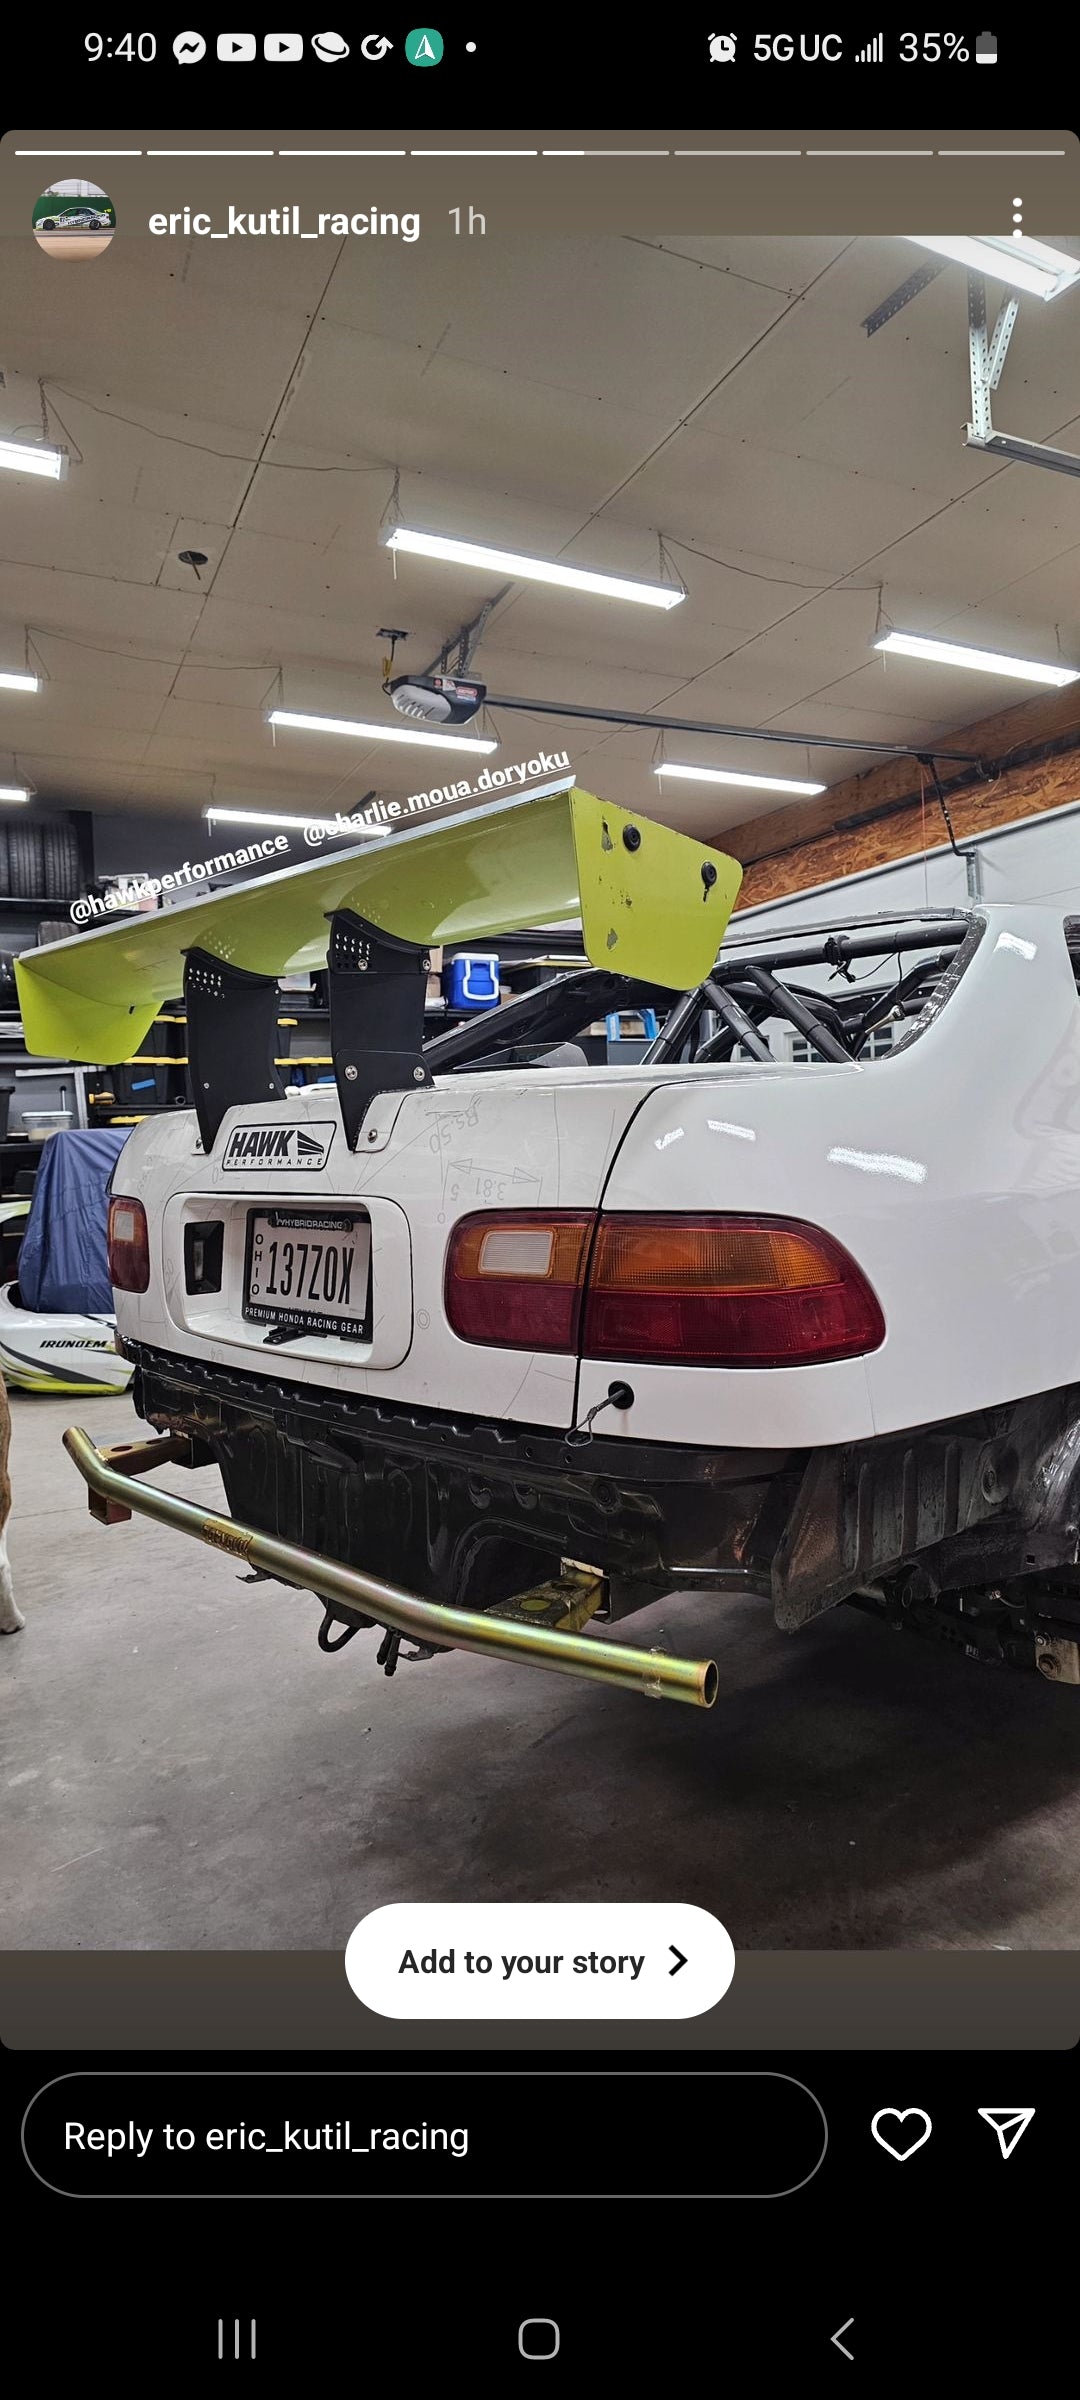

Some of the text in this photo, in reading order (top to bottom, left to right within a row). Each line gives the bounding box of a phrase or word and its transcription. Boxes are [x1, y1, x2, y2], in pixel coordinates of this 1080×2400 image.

[228, 1129, 296, 1158] HAWK
[225, 1158, 323, 1166] PERFORMANCE
[251, 1233, 264, 1295] OHIO
[244, 1306, 276, 1320] PREMIUM
[278, 1312, 304, 1325] HONDA
[306, 1316, 338, 1331] RACING
[340, 1322, 364, 1335] GEAR
